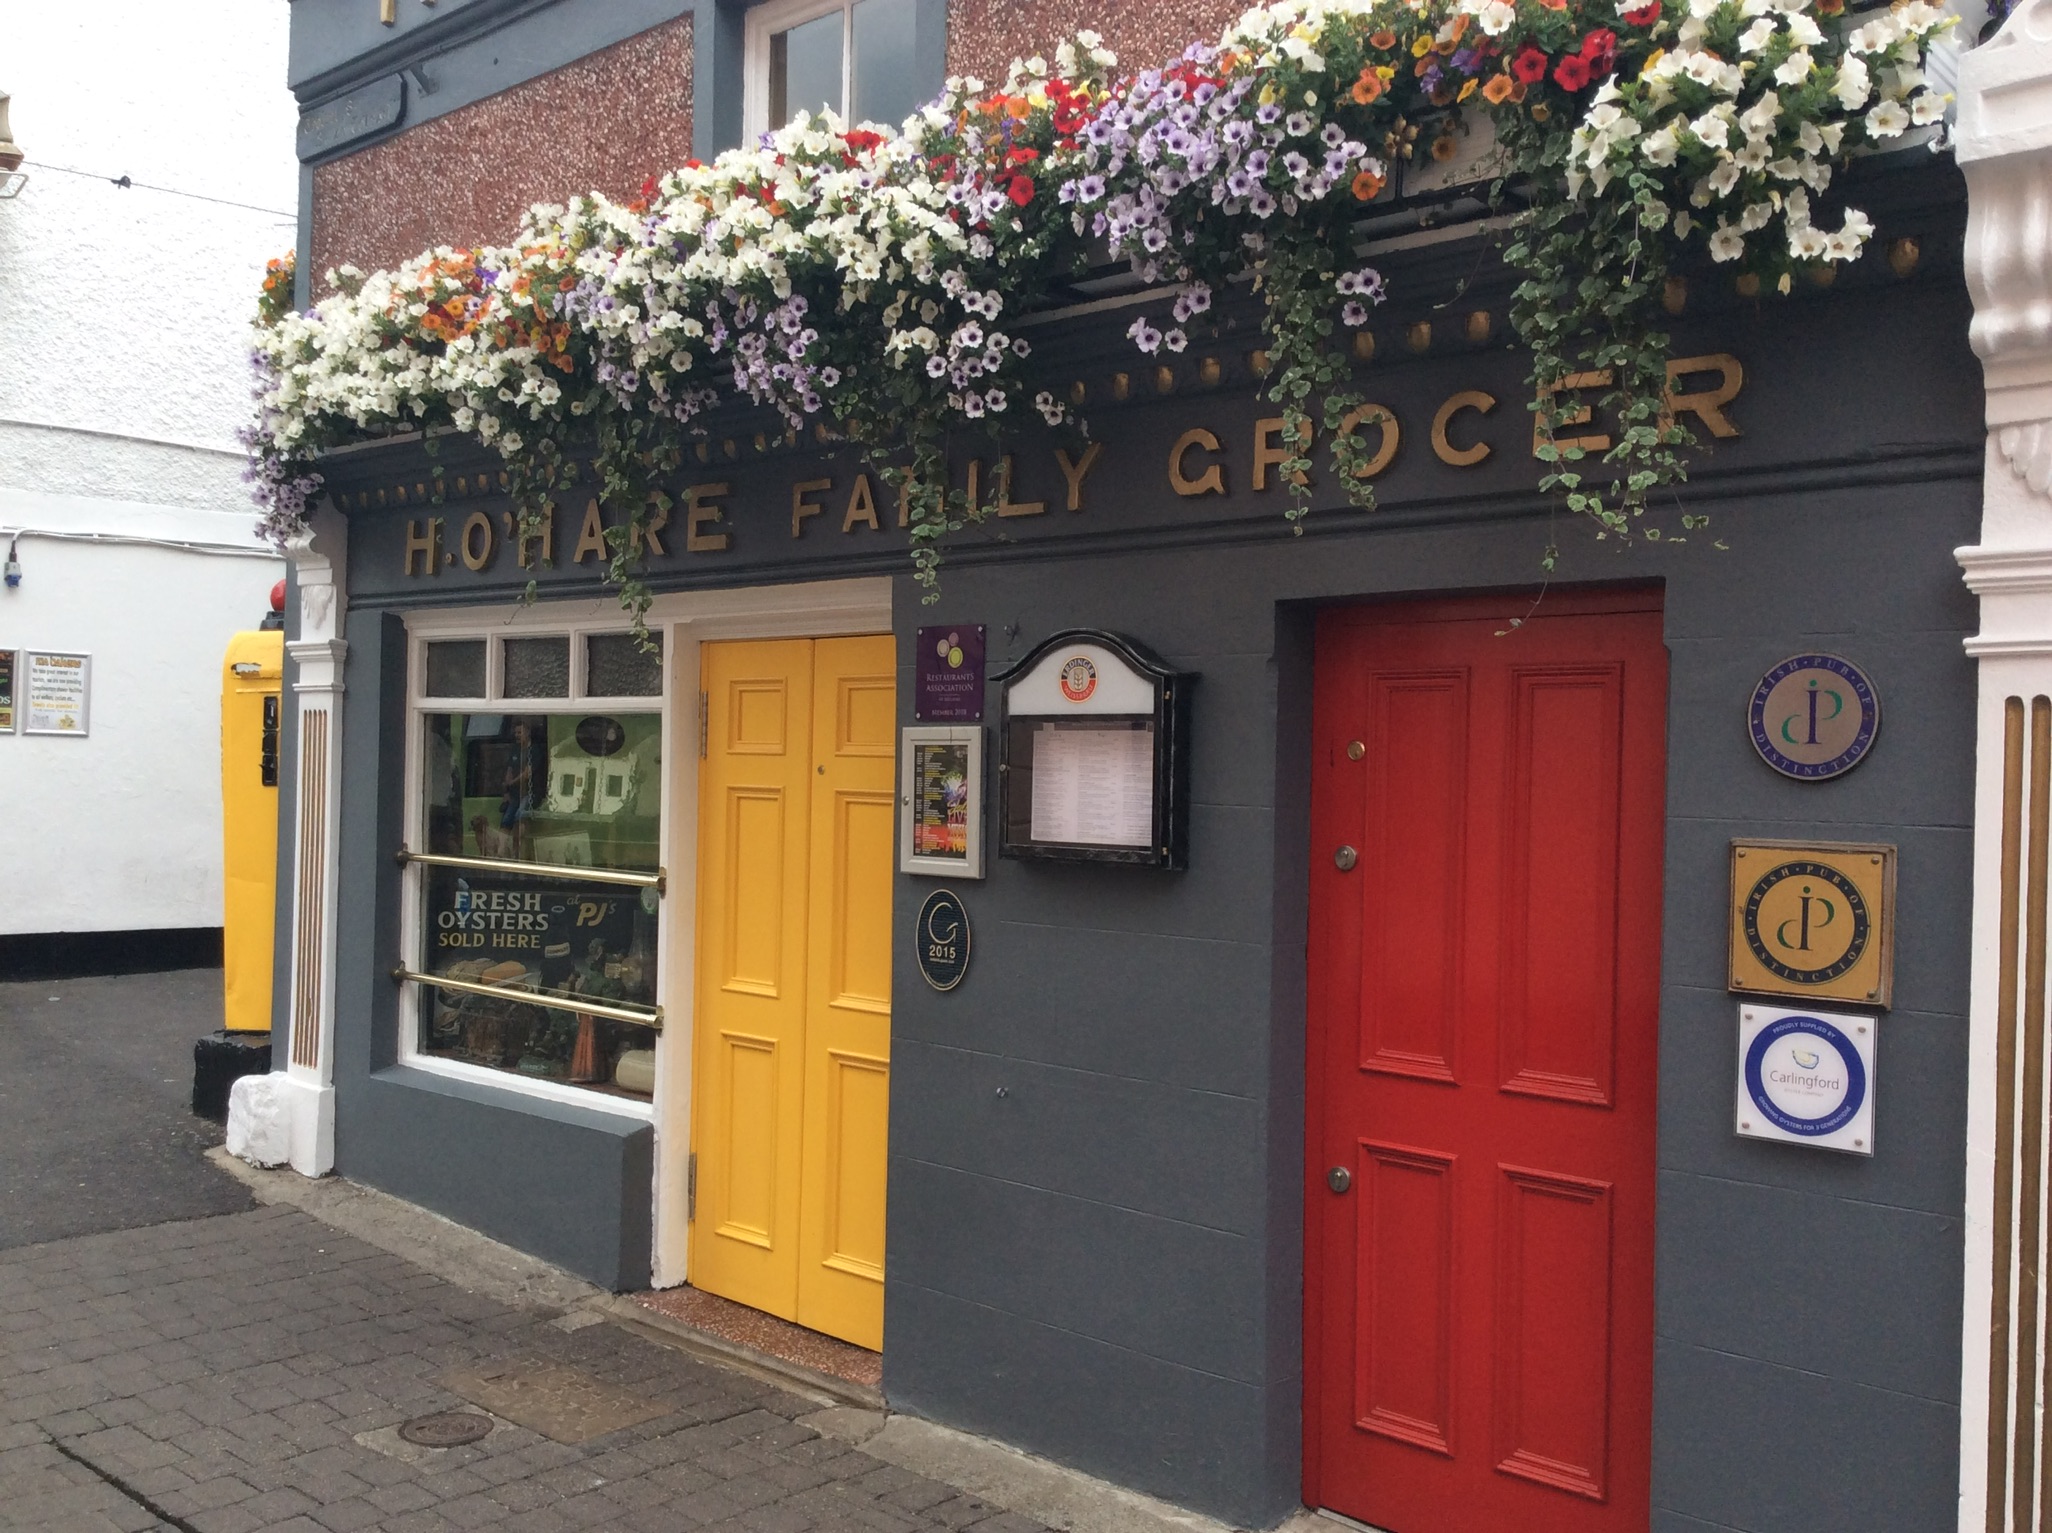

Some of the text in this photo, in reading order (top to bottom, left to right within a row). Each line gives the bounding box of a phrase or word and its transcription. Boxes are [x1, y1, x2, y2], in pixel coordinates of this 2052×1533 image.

[1168, 353, 1743, 495] GROCER
[926, 673, 975, 681] RESTAURANTS
[1063, 658, 1095, 677] ERDINGER
[926, 683, 974, 691] ASSOCIATION
[1756, 658, 1872, 775] IRISH PUB OF DISTINCTION
[454, 891, 542, 912] FRESH
[437, 911, 549, 931] OYSTERS
[576, 899, 617, 927] PJ's
[1748, 865, 1864, 981] IRISH PUB OF DISTINCTION
[438, 933, 541, 949] SOLD HERE
[929, 944, 956, 959] 2015
[1773, 1021, 1836, 1039] PROUDLY SUPPLIED BY
[1770, 1070, 1840, 1090] Carlingford
[1759, 1095, 1779, 1120] GROWING
[1779, 1117, 1802, 1130] OYSTERS
[1820, 1105, 1852, 1130] GENERATIONS
